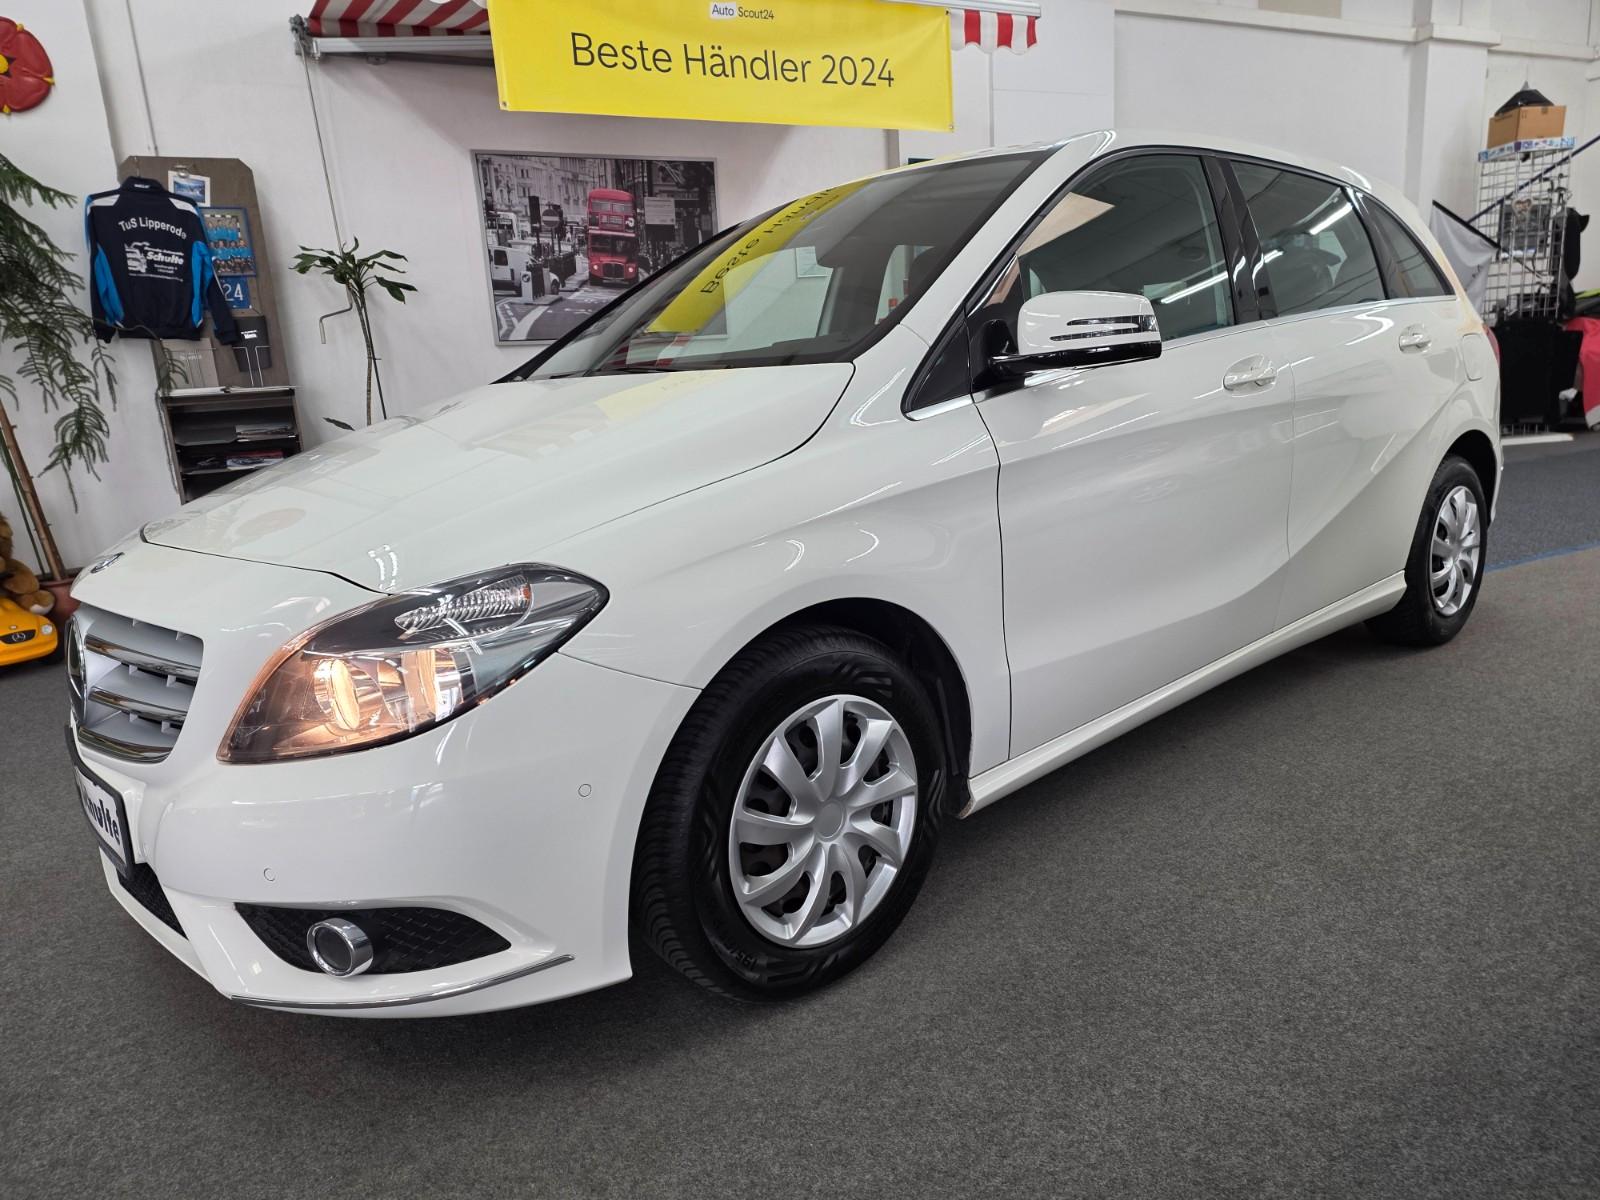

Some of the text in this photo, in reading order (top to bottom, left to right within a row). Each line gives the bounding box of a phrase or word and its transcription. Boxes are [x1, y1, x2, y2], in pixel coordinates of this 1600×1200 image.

[711, 3, 775, 20] Auto Scout24
[571, 32, 894, 88] Beste Händler 2024
[118, 216, 187, 240] TuS Lipperode
